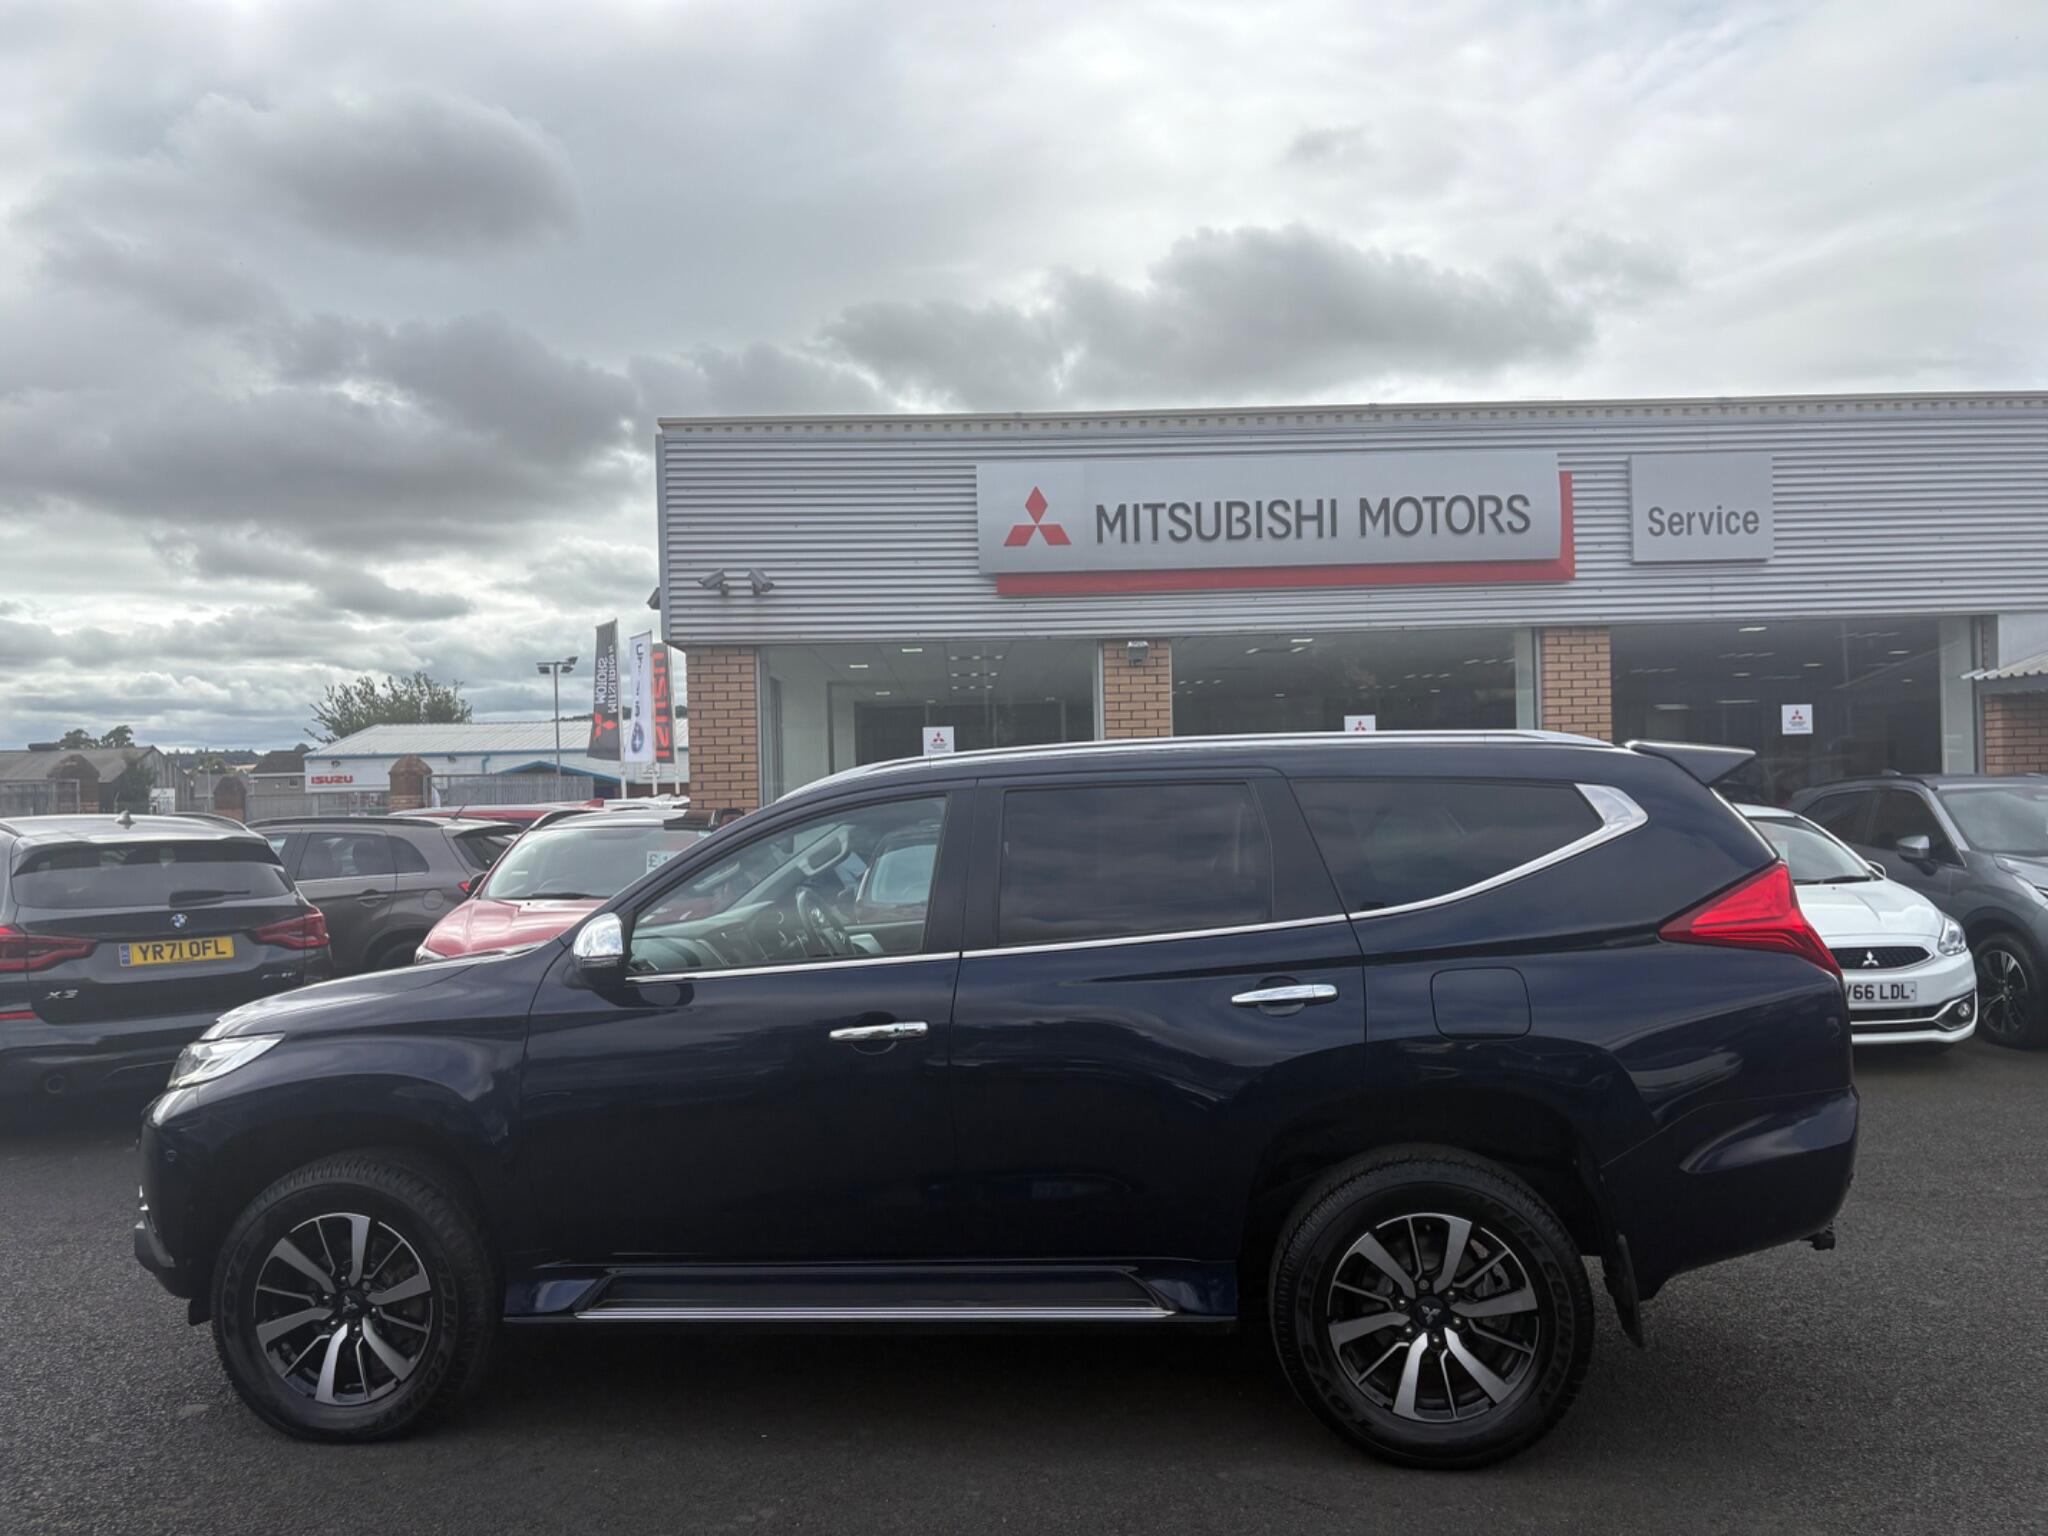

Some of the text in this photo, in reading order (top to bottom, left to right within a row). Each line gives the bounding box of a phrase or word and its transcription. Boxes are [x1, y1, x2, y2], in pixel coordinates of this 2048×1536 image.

[1096, 494, 1532, 544] MITSUBISHI MOTORS
[1648, 505, 1760, 537] Service
[311, 775, 353, 785] ISUZU
[138, 940, 226, 961] YR71 OFL
[1879, 983, 1910, 999] LDL
